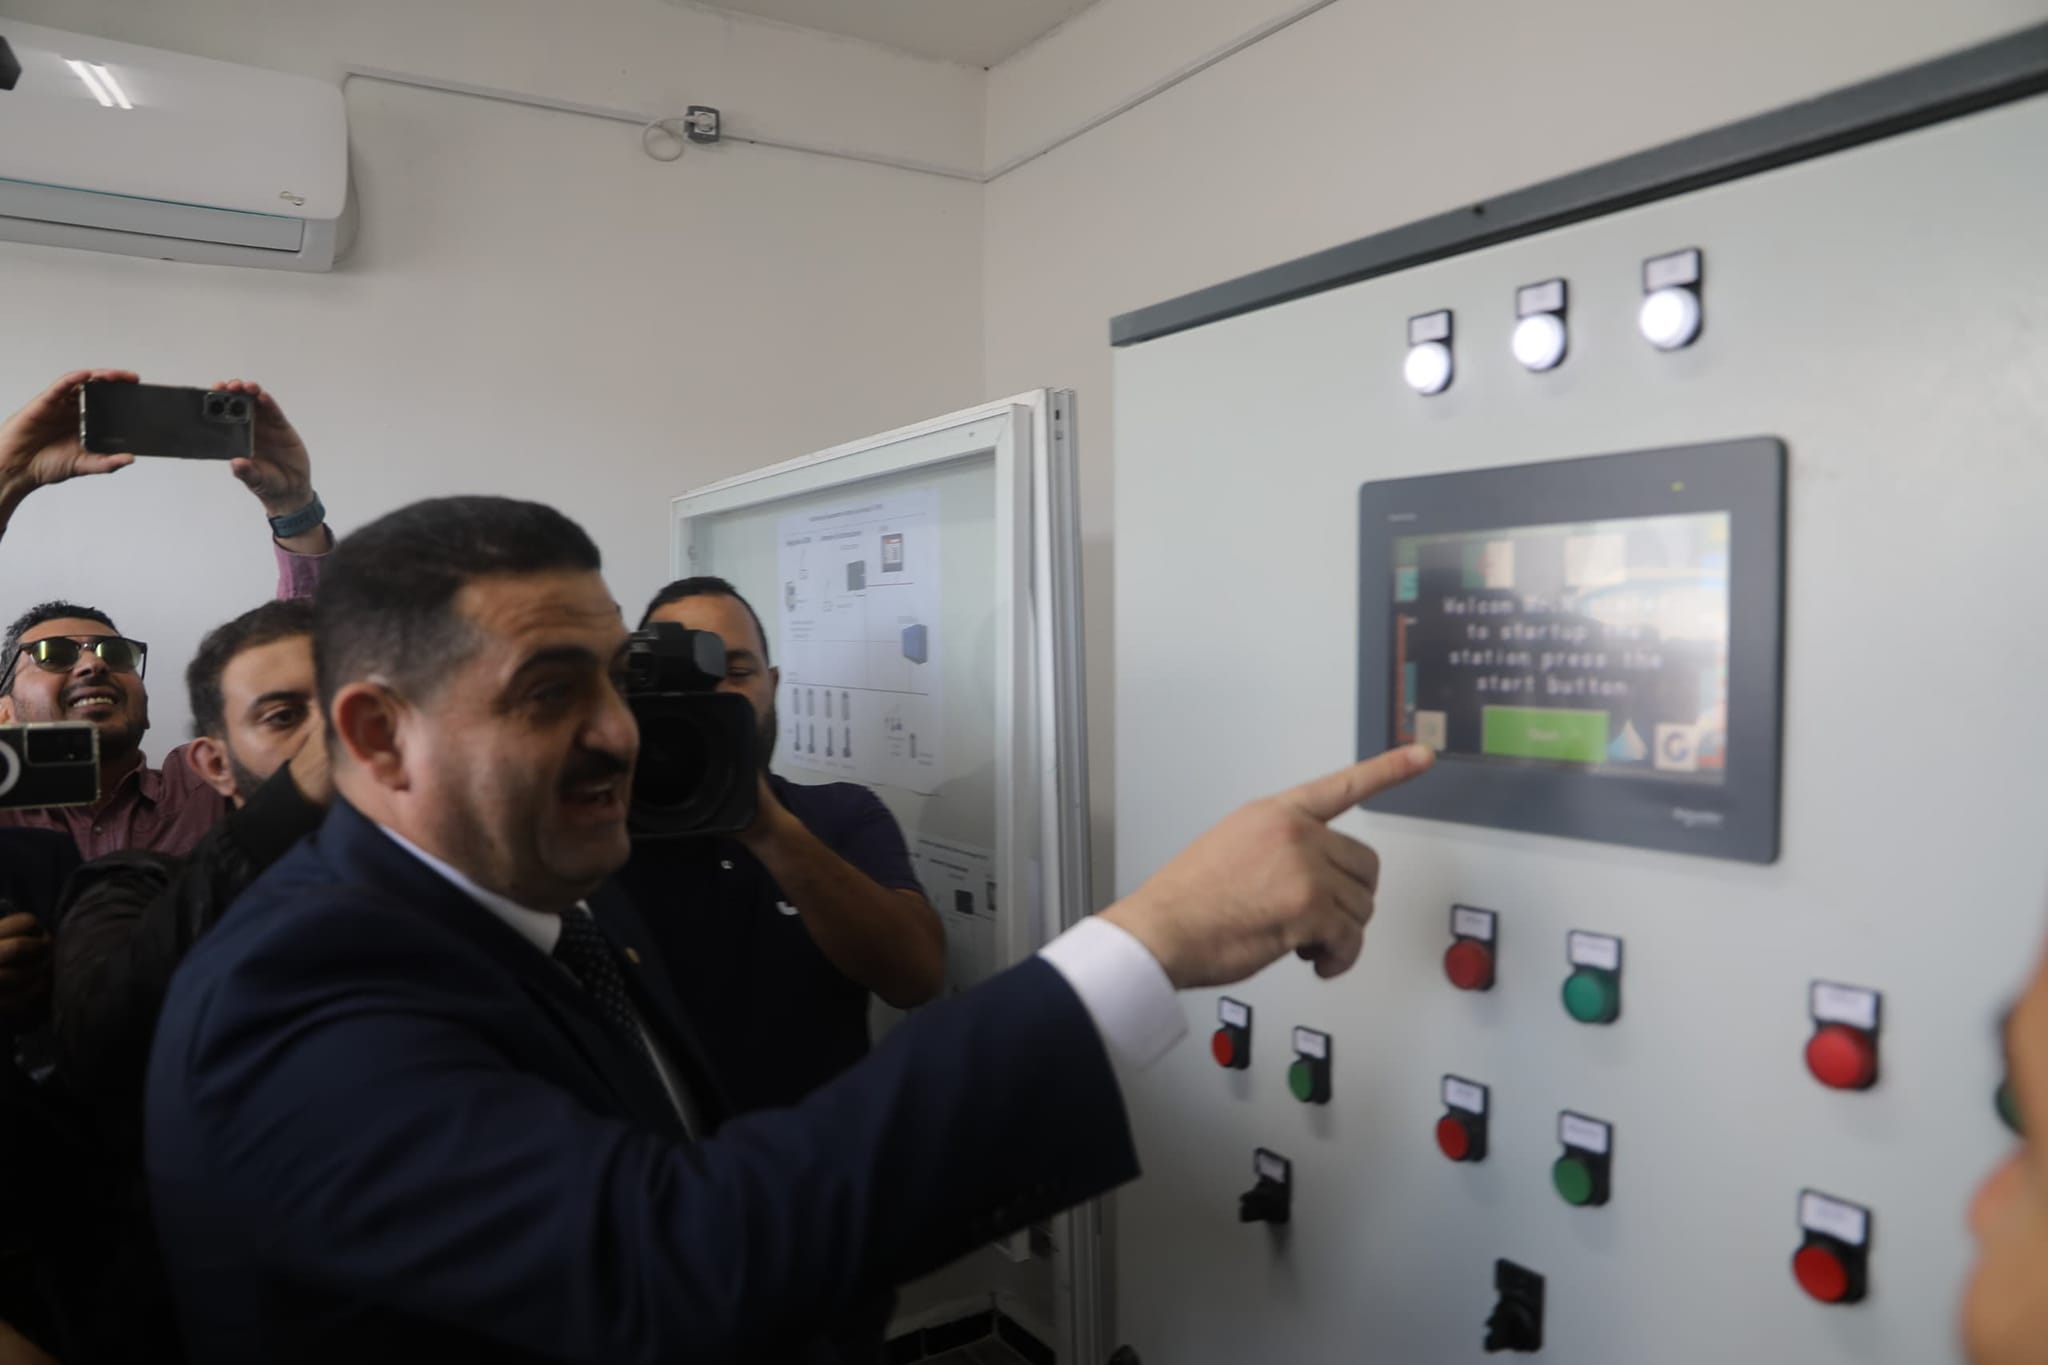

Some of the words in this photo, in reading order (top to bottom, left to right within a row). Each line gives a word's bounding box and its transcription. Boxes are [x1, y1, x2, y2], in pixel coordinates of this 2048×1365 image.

[1467, 623, 1490, 641] to
[1500, 622, 1588, 647] startup
[1448, 649, 1532, 666] station
[1540, 651, 1608, 673] press
[1622, 649, 1665, 669] the
[1476, 674, 1535, 693] start
[1546, 674, 1630, 696] button
